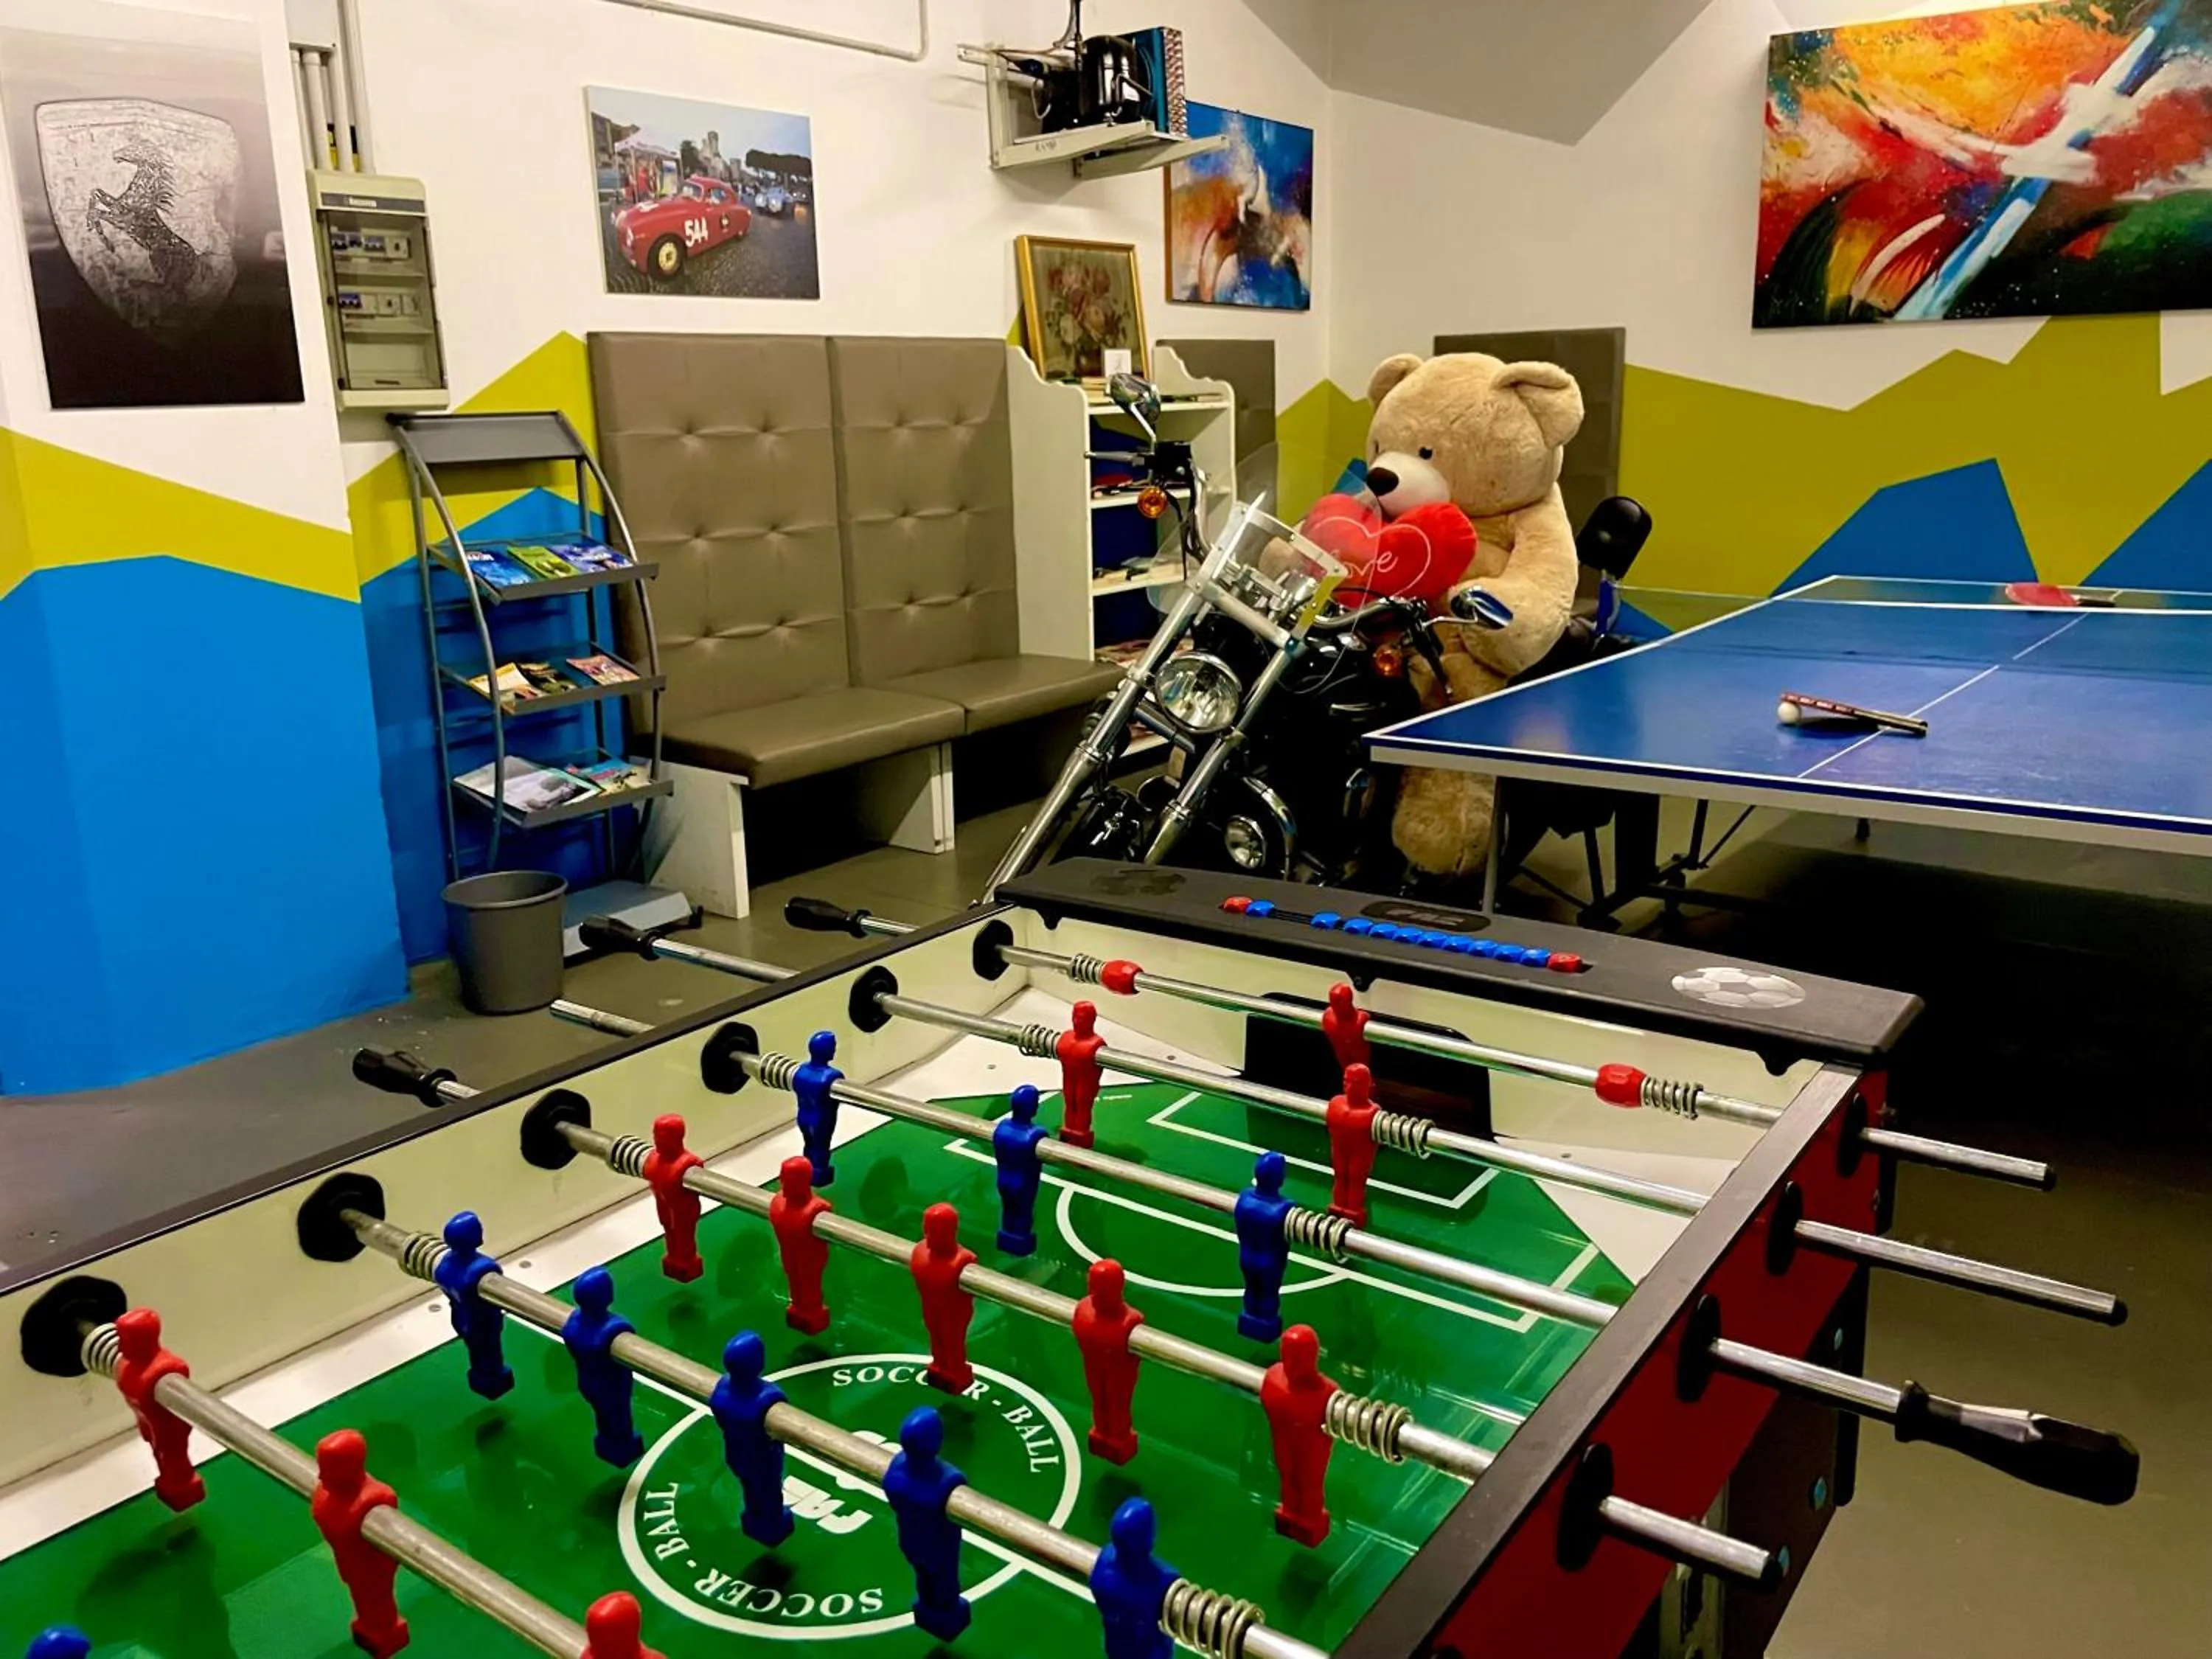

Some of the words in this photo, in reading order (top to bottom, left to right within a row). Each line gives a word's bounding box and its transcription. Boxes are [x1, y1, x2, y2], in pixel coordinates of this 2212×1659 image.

[684, 217, 709, 248] 544
[832, 1366, 990, 1401] SOCCR
[1001, 1404, 1060, 1473] BALL
[643, 1482, 690, 1561] BALL
[694, 1567, 883, 1618] SOCCER
